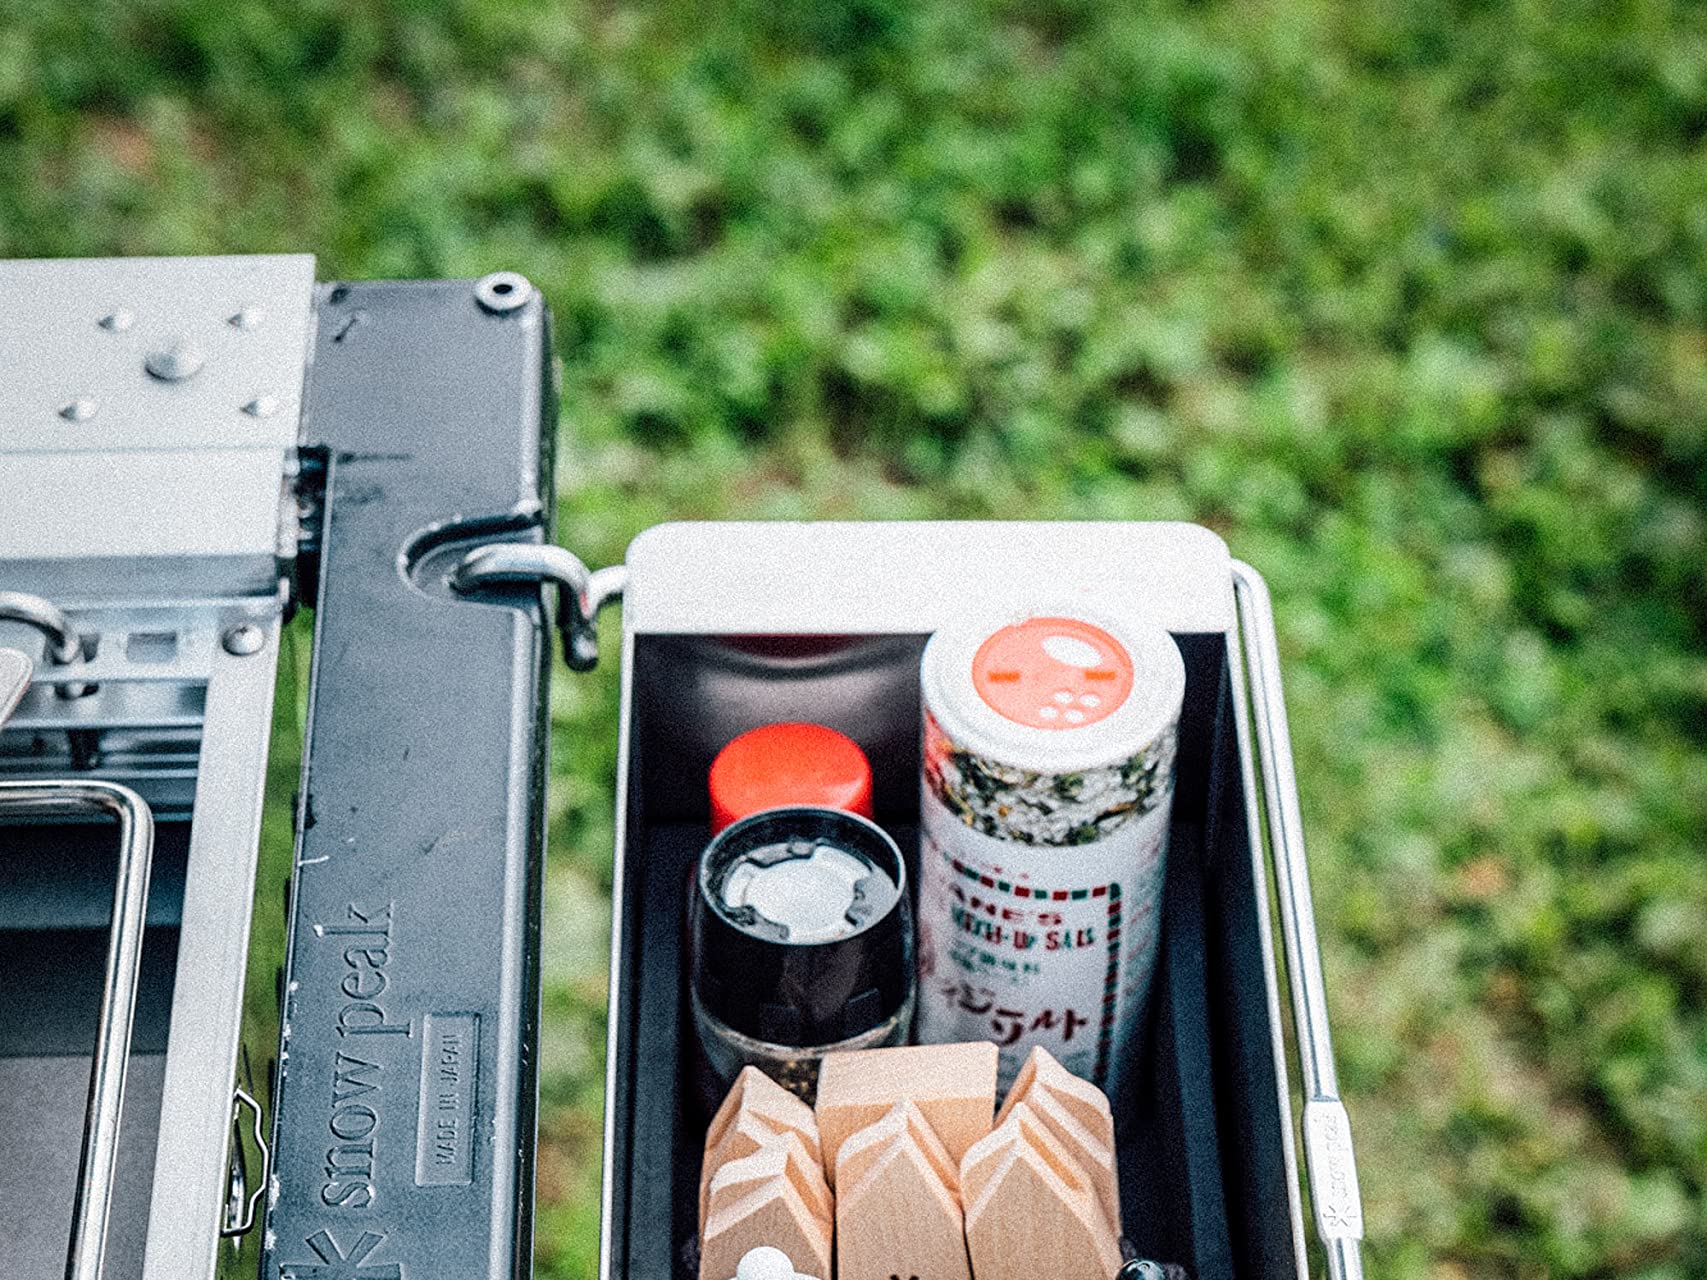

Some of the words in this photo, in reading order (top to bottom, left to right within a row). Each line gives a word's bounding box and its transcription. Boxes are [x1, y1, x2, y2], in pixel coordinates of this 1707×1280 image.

[314, 899, 412, 1037] peak
[441, 1035, 462, 1087] JAPAN
[441, 1089, 459, 1111] IN
[320, 1051, 380, 1209] snow
[435, 1118, 457, 1165] MADE
